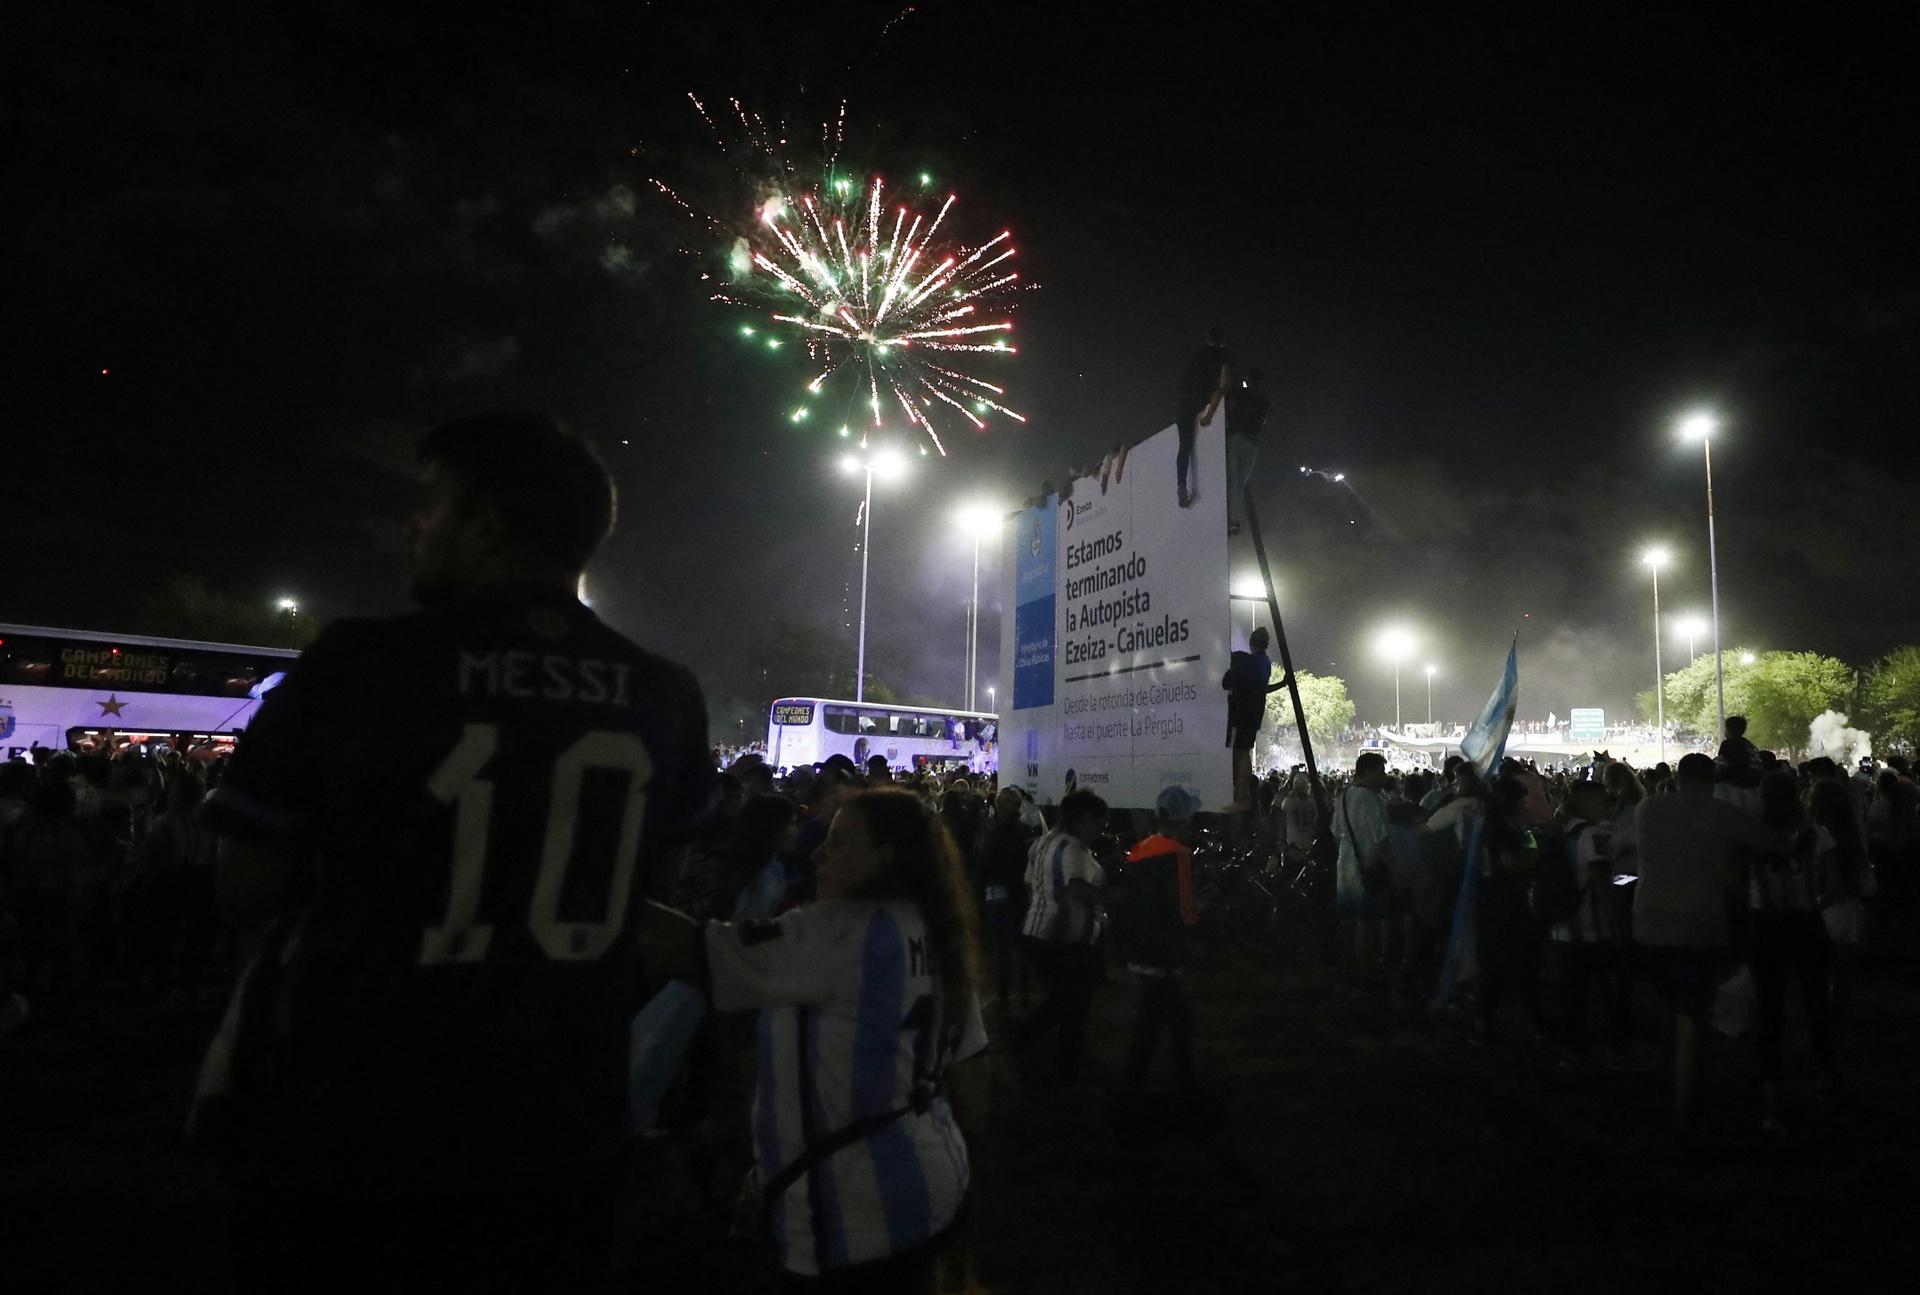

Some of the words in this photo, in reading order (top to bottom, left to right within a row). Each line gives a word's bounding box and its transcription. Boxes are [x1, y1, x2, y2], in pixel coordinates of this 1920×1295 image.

[1066, 530, 1123, 569] Estamos
[1066, 551, 1146, 601] terminando
[1066, 607, 1077, 633] la
[1079, 587, 1151, 629] Autopista
[1065, 634, 1106, 665] Ezeiza
[1117, 613, 1189, 654] Cañuelas
[61, 648, 169, 670] CAMPEONES
[64, 663, 100, 679] DEL
[107, 668, 167, 684] MUNDO
[458, 650, 631, 706] MESSI
[776, 706, 811, 715] CAMPEONES
[1064, 694, 1089, 715] Desde
[1090, 693, 1097, 711] la
[1099, 687, 1134, 711] rotonda
[1136, 687, 1149, 706] de
[1150, 680, 1197, 704] Cañuelas
[789, 715, 810, 724] MUNDO
[1064, 722, 1086, 740] hasta
[1088, 720, 1095, 739] el
[1096, 719, 1129, 744] puente
[1131, 716, 1142, 737] La
[1145, 712, 1184, 740] Pérgola
[1027, 763, 1039, 777] VN
[1079, 772, 1109, 784] corredores
[417, 722, 655, 966] 10
